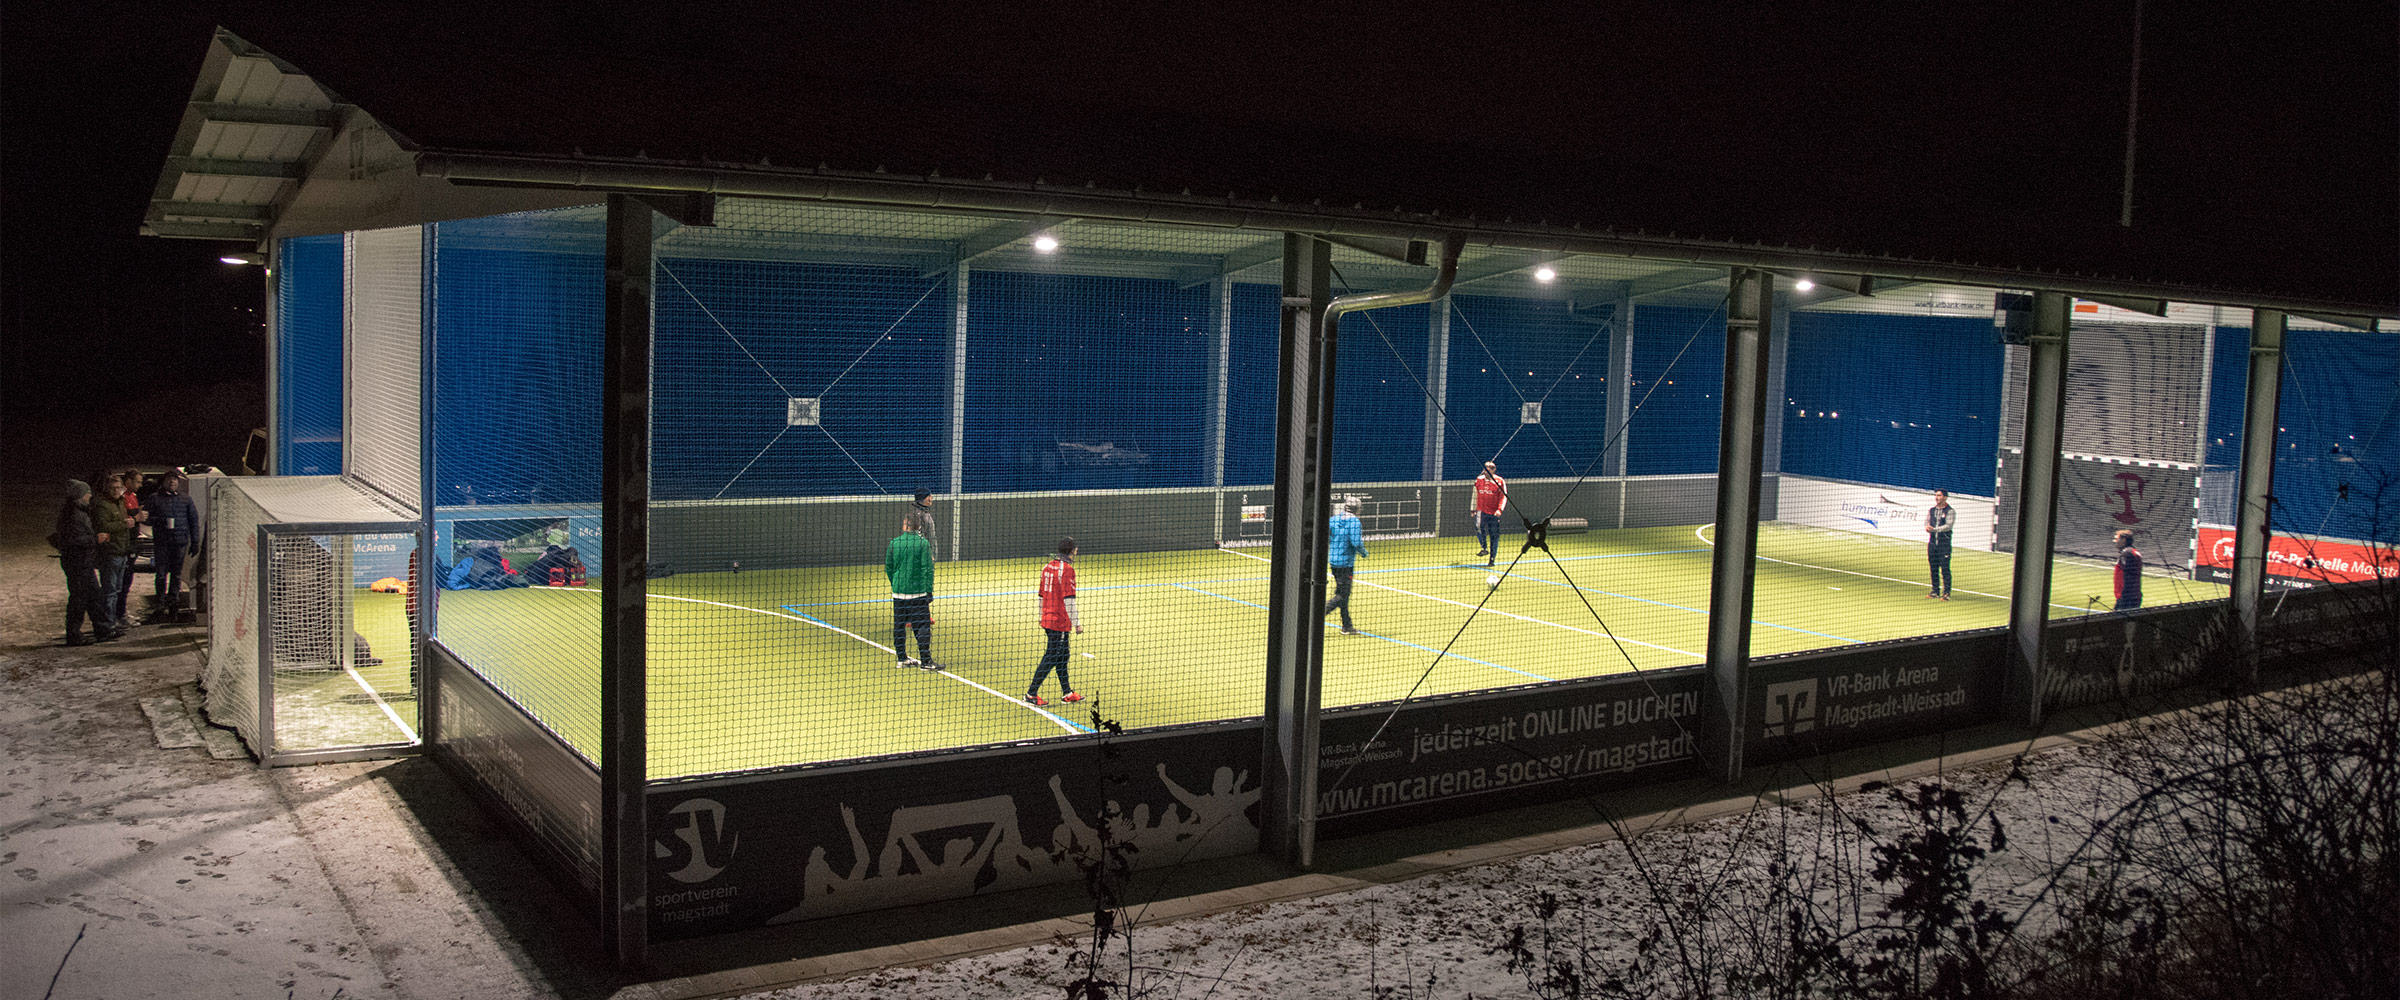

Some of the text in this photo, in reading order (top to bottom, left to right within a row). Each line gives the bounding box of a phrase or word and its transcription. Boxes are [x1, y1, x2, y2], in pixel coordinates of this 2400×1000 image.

[1842, 501, 1918, 521] hummel print
[1828, 666, 1939, 697] VR-Bank Arena
[1824, 684, 1966, 728] Magstadt-Weissach
[1410, 690, 1698, 763] jederzeit ONLINE BUCHEN
[655, 883, 738, 908] sportverein
[663, 901, 730, 923] magstadt
